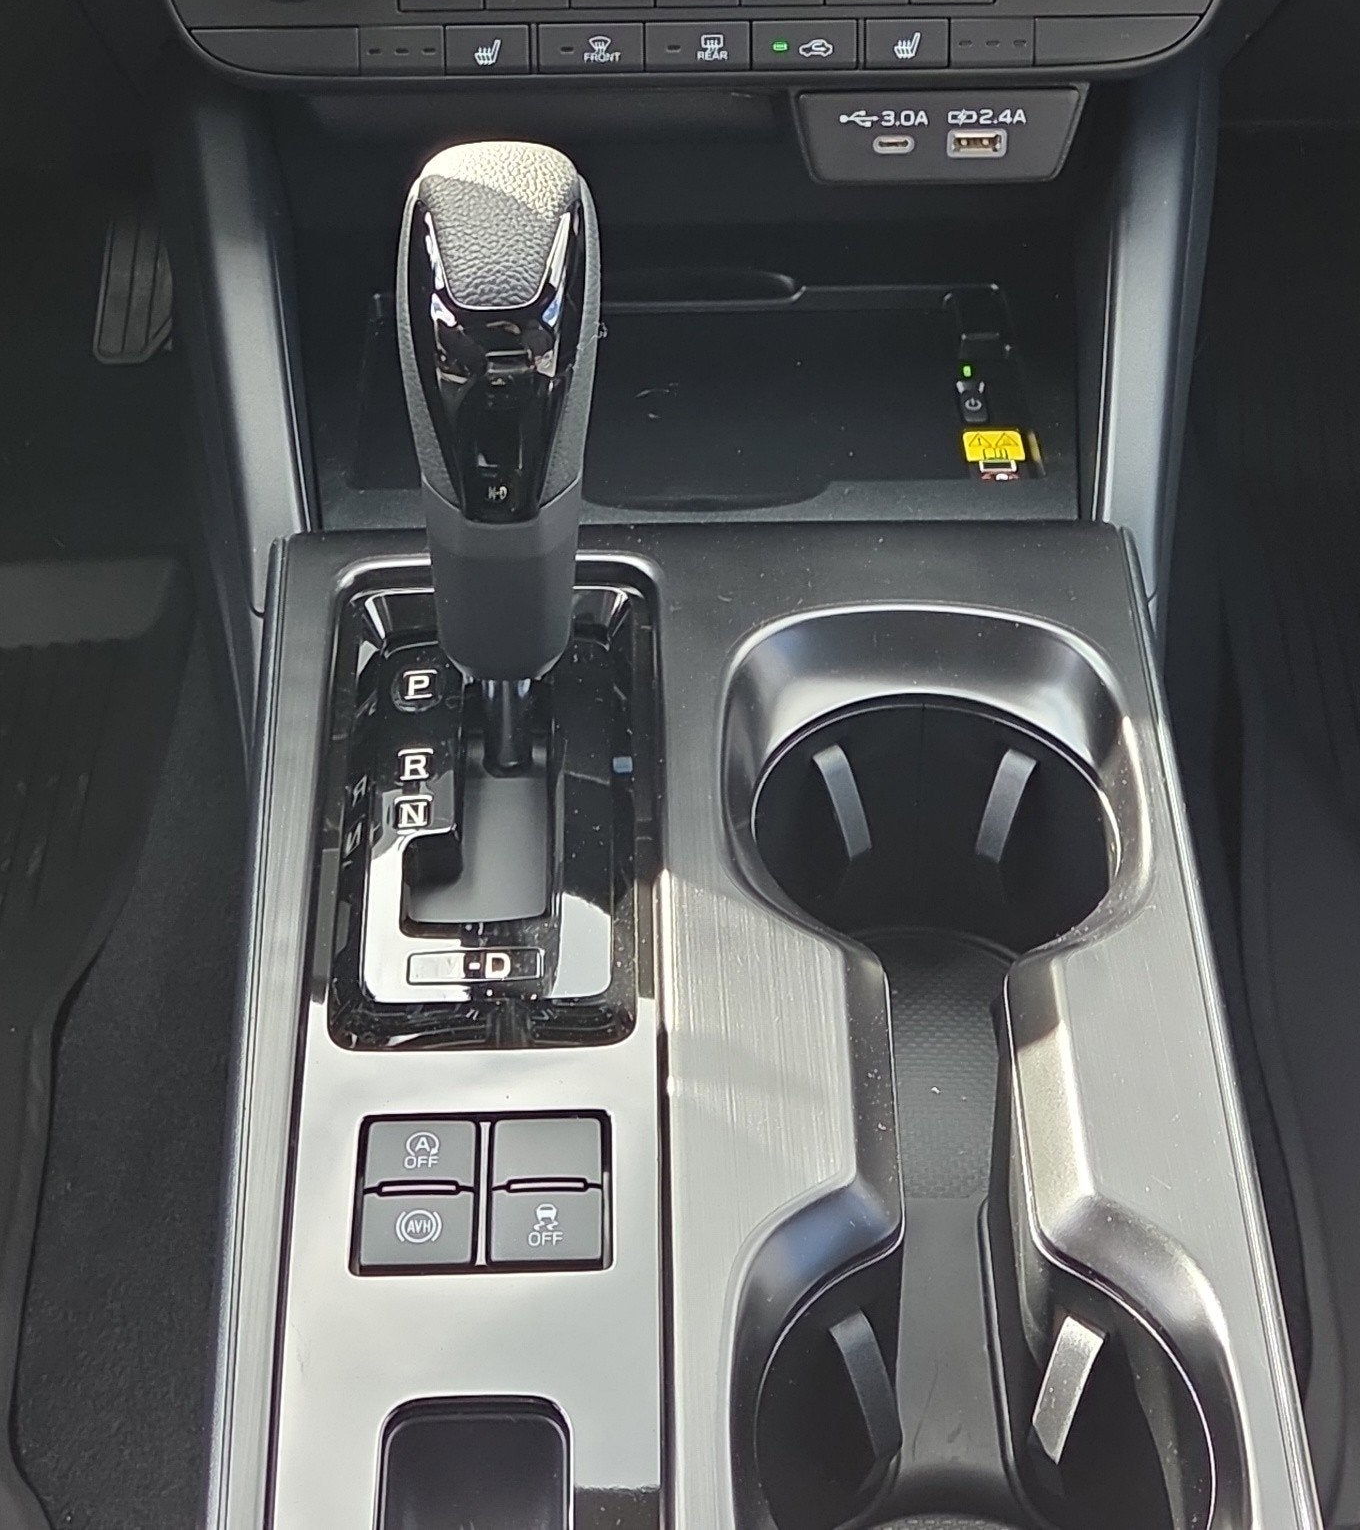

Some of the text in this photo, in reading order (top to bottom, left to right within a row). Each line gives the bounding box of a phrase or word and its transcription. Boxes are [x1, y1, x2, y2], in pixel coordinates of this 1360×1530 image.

[583, 51, 622, 63] FRONT
[696, 50, 729, 62] REAR
[880, 109, 929, 127] 3.0A
[978, 108, 1027, 126] 2.4A
[406, 674, 431, 699] P
[400, 754, 430, 780] R
[397, 801, 429, 828] N
[415, 1136, 431, 1152] A
[404, 1155, 439, 1169] OFF
[406, 1219, 431, 1233] AVH
[528, 1231, 564, 1246] OFF
